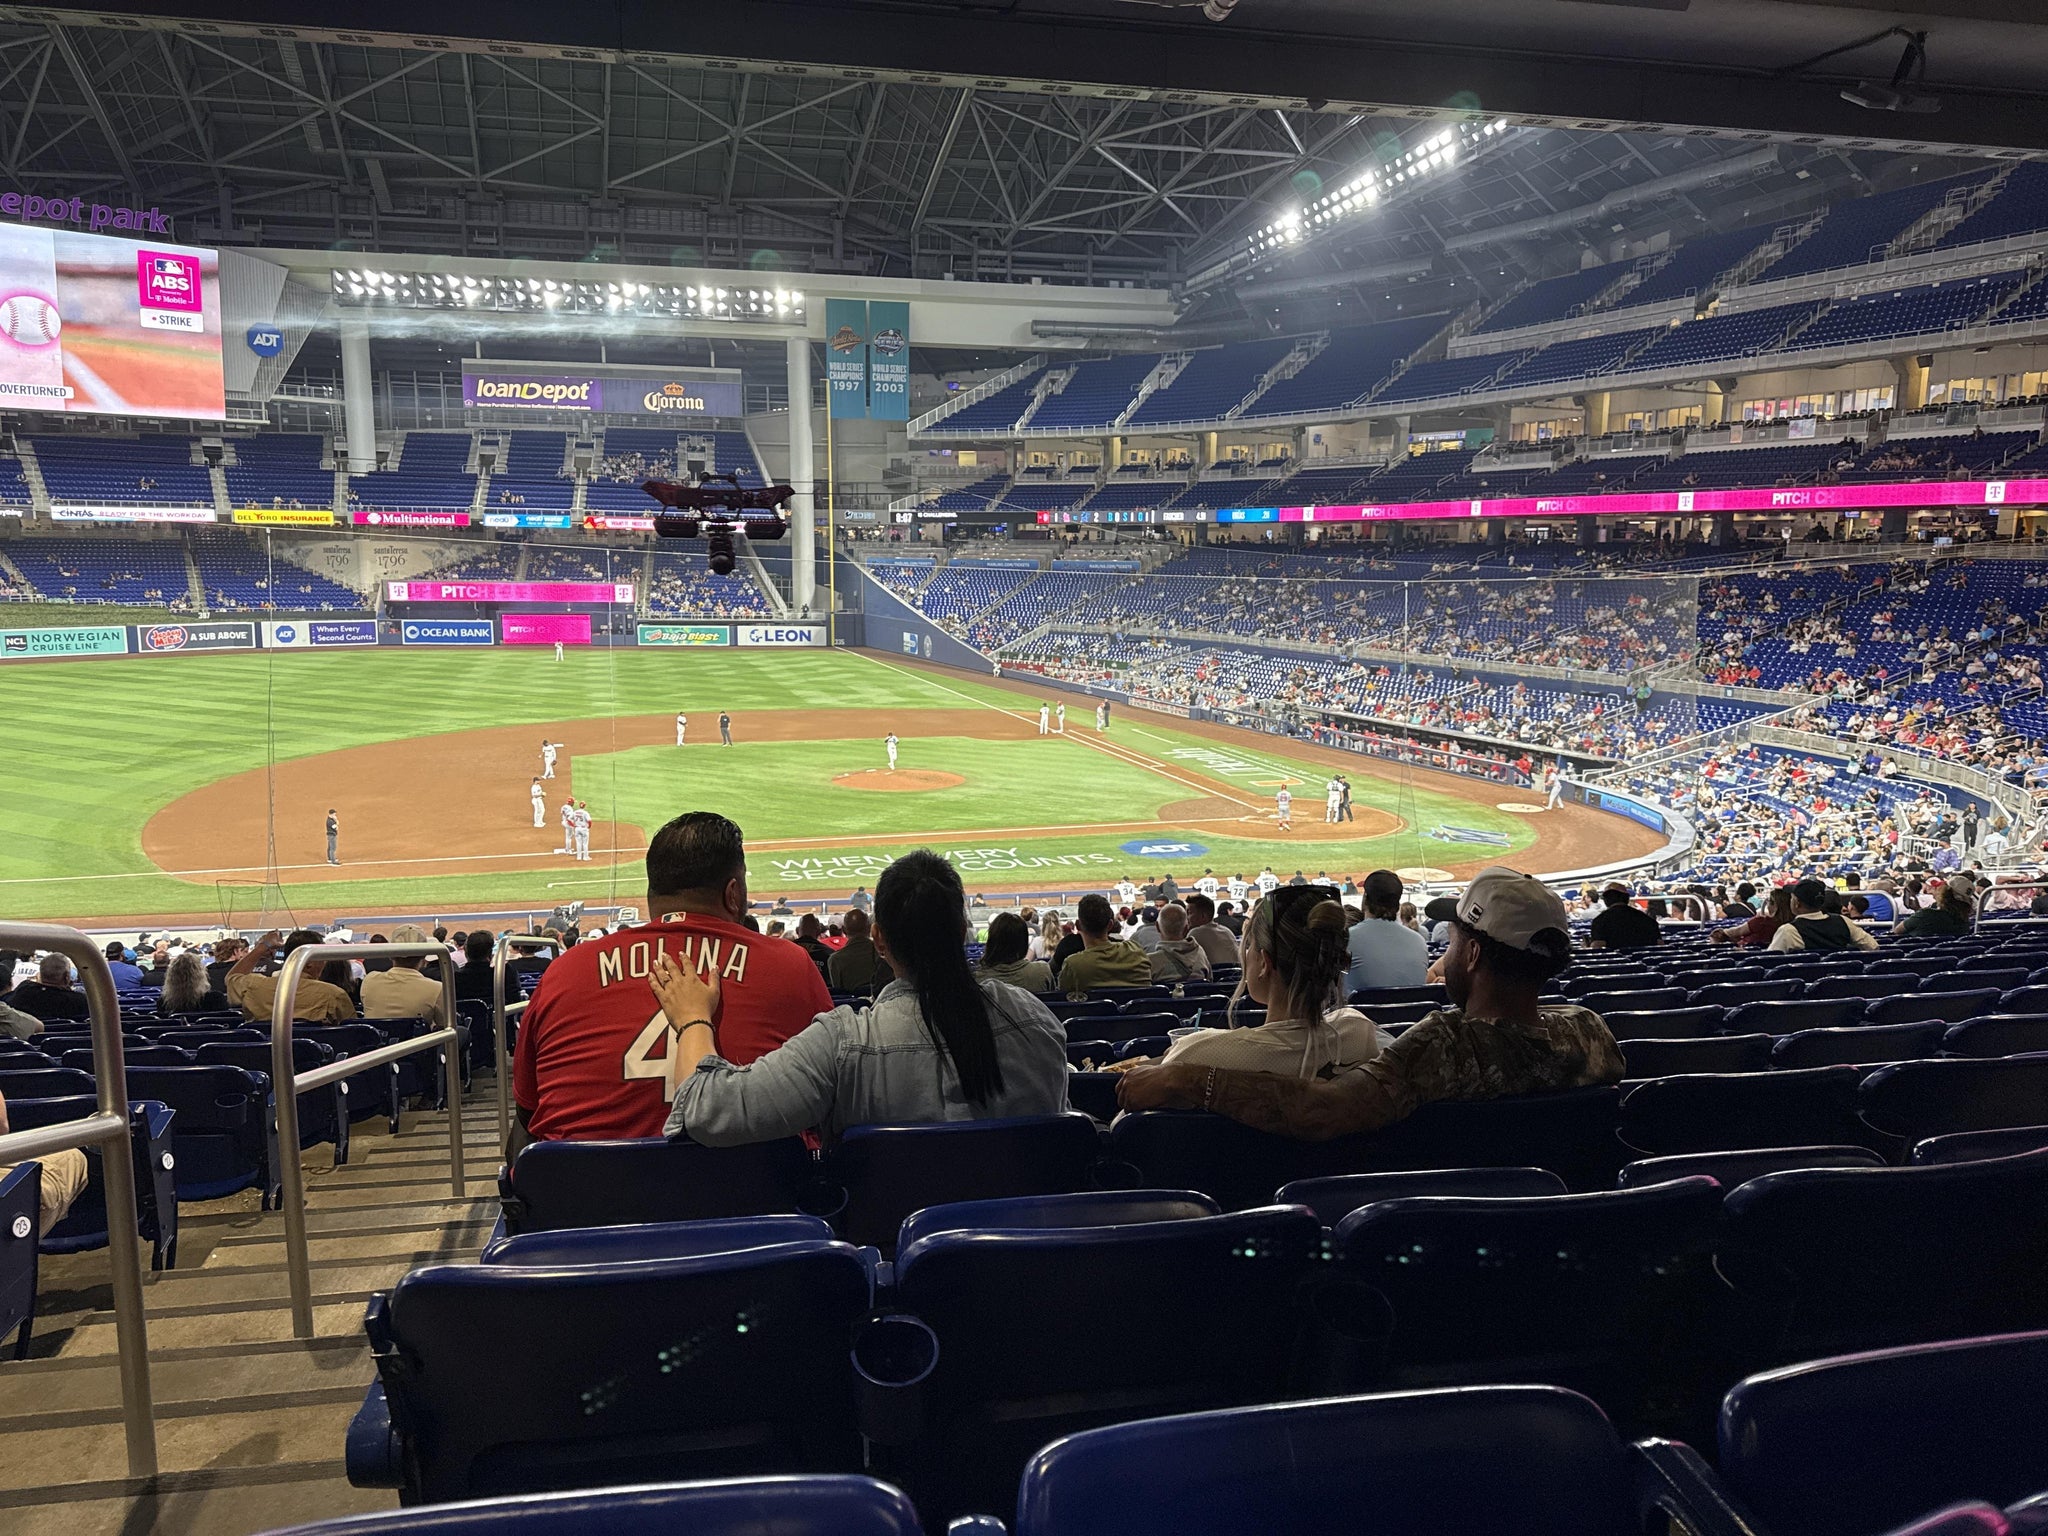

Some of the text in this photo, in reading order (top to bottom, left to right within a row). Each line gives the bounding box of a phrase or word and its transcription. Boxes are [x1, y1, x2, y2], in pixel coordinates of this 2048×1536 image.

[89, 203, 169, 233] park
[152, 275, 189, 291] ABS
[159, 315, 192, 327] STRIKE
[253, 333, 280, 347] ADT
[829, 371, 863, 380] CHAMPIONS
[872, 373, 906, 382] CHAMPIONS
[0, 383, 67, 397] OVERTURNED
[476, 379, 590, 404] loanDepot
[833, 381, 859, 391] 1997
[875, 383, 904, 393] 2003
[643, 391, 705, 413] Corona
[1772, 492, 1810, 504] PITCH
[1536, 501, 1563, 511] PITCH
[382, 514, 455, 524] Multinational
[326, 555, 349, 568] 1796
[379, 555, 406, 568] 1796
[31, 632, 120, 643] NORWEGIAN
[190, 632, 248, 641] A SUB ABOVE
[279, 630, 293, 638] ADT
[317, 633, 344, 641] Second
[421, 628, 490, 637] OCEAN BANK
[662, 631, 687, 641] Baja
[687, 631, 719, 641] Blast
[764, 630, 811, 642] LEON
[32, 643, 71, 651] CRUISE
[1140, 844, 1191, 853] ADT
[770, 854, 896, 870] WHEN
[779, 853, 1123, 881] SECO COUNTS.
[1264, 881, 1274, 889] 56
[1233, 888, 1243, 896] 72
[623, 1007, 679, 1103] 4
[16, 1219, 28, 1235] 23
